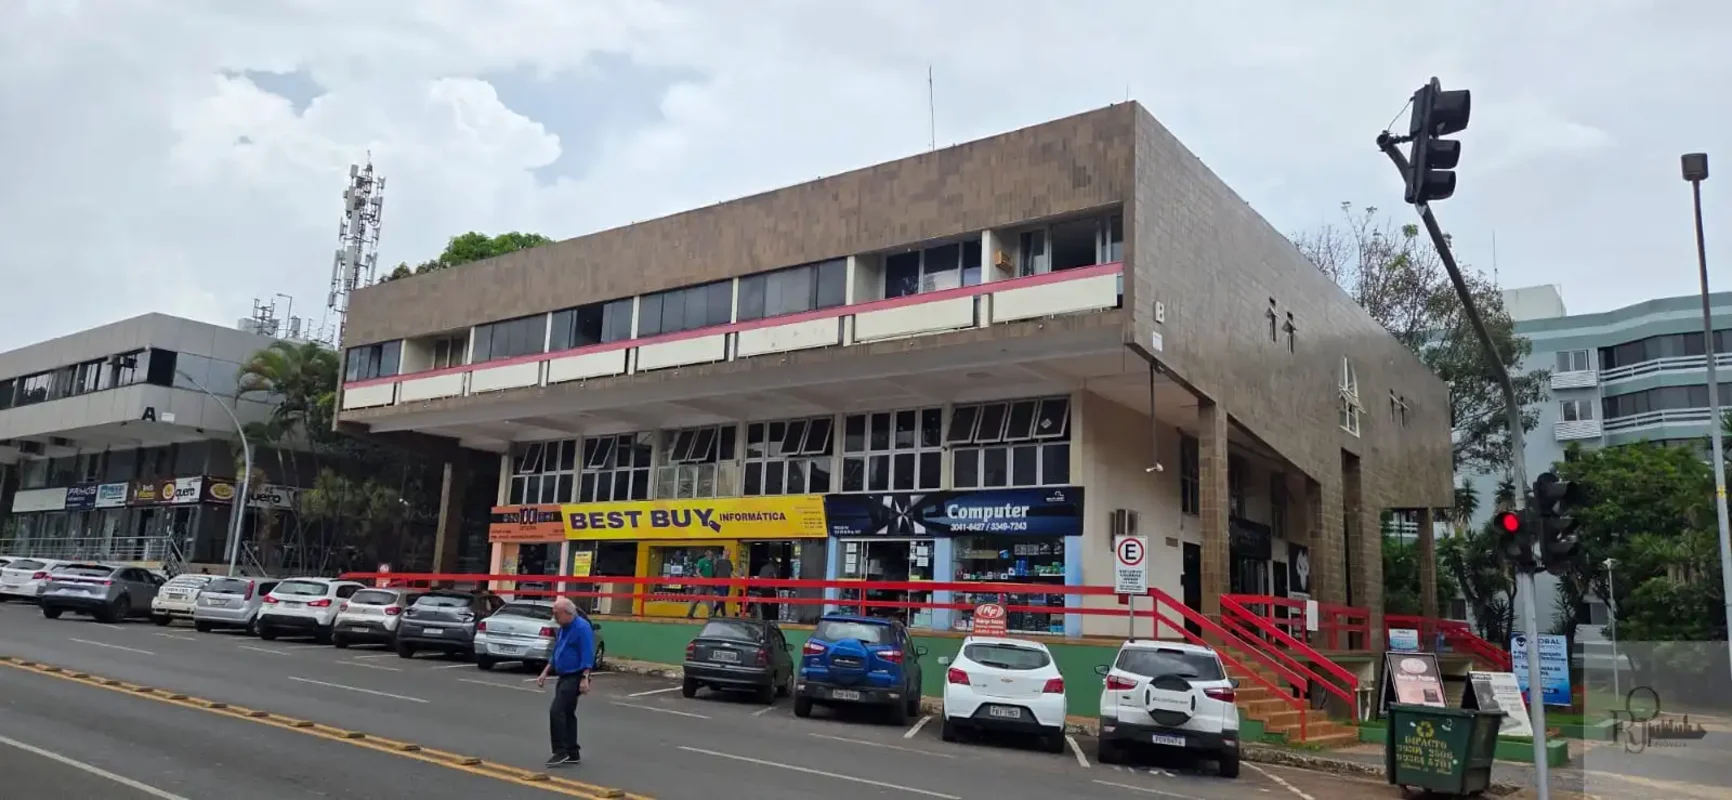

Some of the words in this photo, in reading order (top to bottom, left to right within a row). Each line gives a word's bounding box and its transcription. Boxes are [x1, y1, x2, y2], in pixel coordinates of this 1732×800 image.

[1155, 301, 1165, 323] B
[141, 406, 157, 422] A
[246, 490, 281, 504] uero
[569, 511, 642, 530] BEST
[650, 508, 714, 528] BUY
[719, 511, 786, 522] INFORMÁTICA
[946, 503, 1030, 522] Computer
[1125, 543, 1137, 560] E
